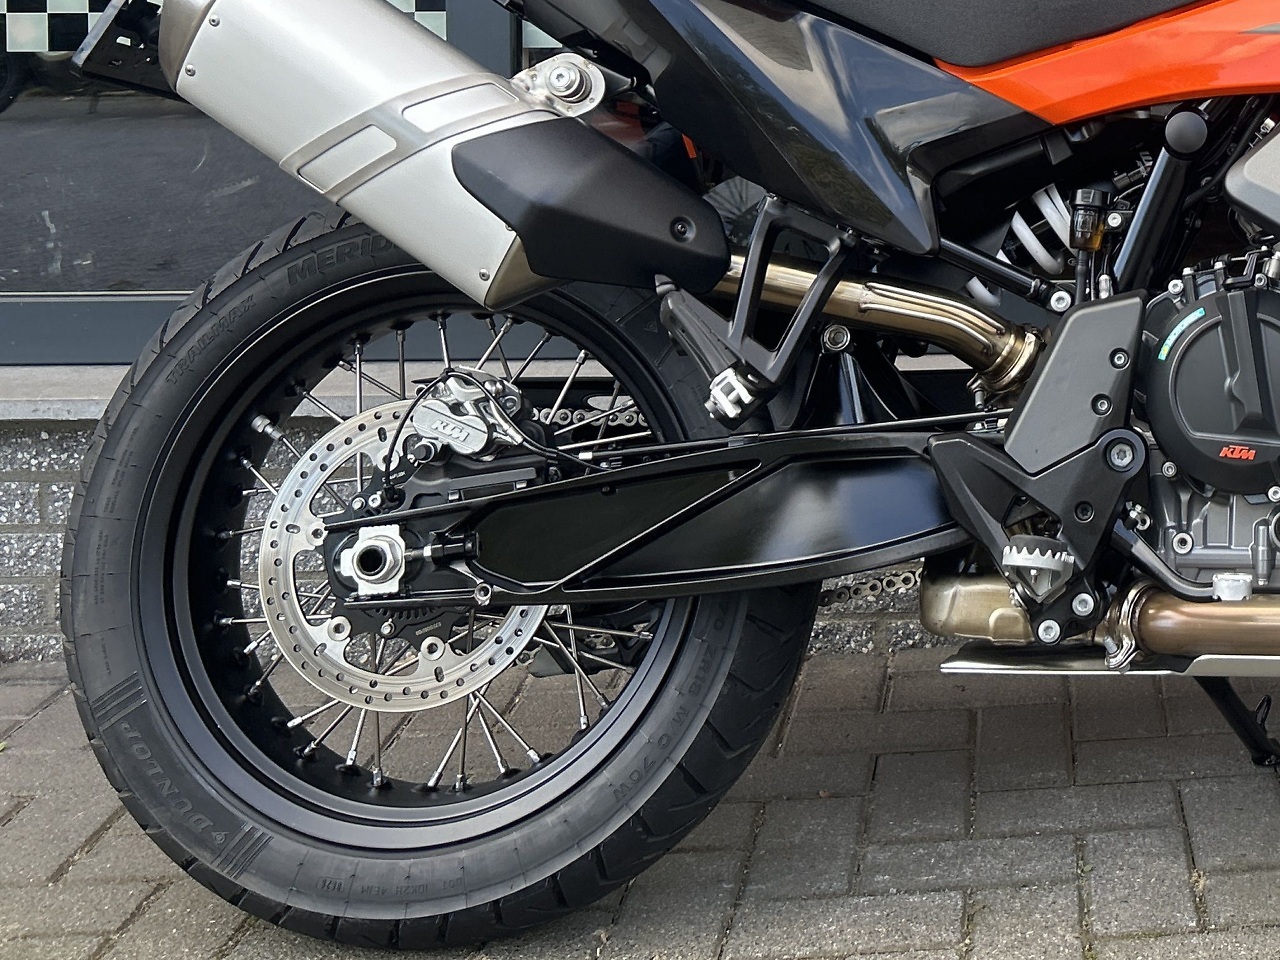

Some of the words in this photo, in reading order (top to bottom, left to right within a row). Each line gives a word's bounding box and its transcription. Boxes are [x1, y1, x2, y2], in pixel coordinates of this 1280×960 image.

[286, 234, 394, 286] MERID
[164, 292, 259, 385] TRAILMAX
[431, 419, 470, 442] KTM
[1219, 445, 1256, 460] KTM
[120, 720, 214, 833] DUNLOP
